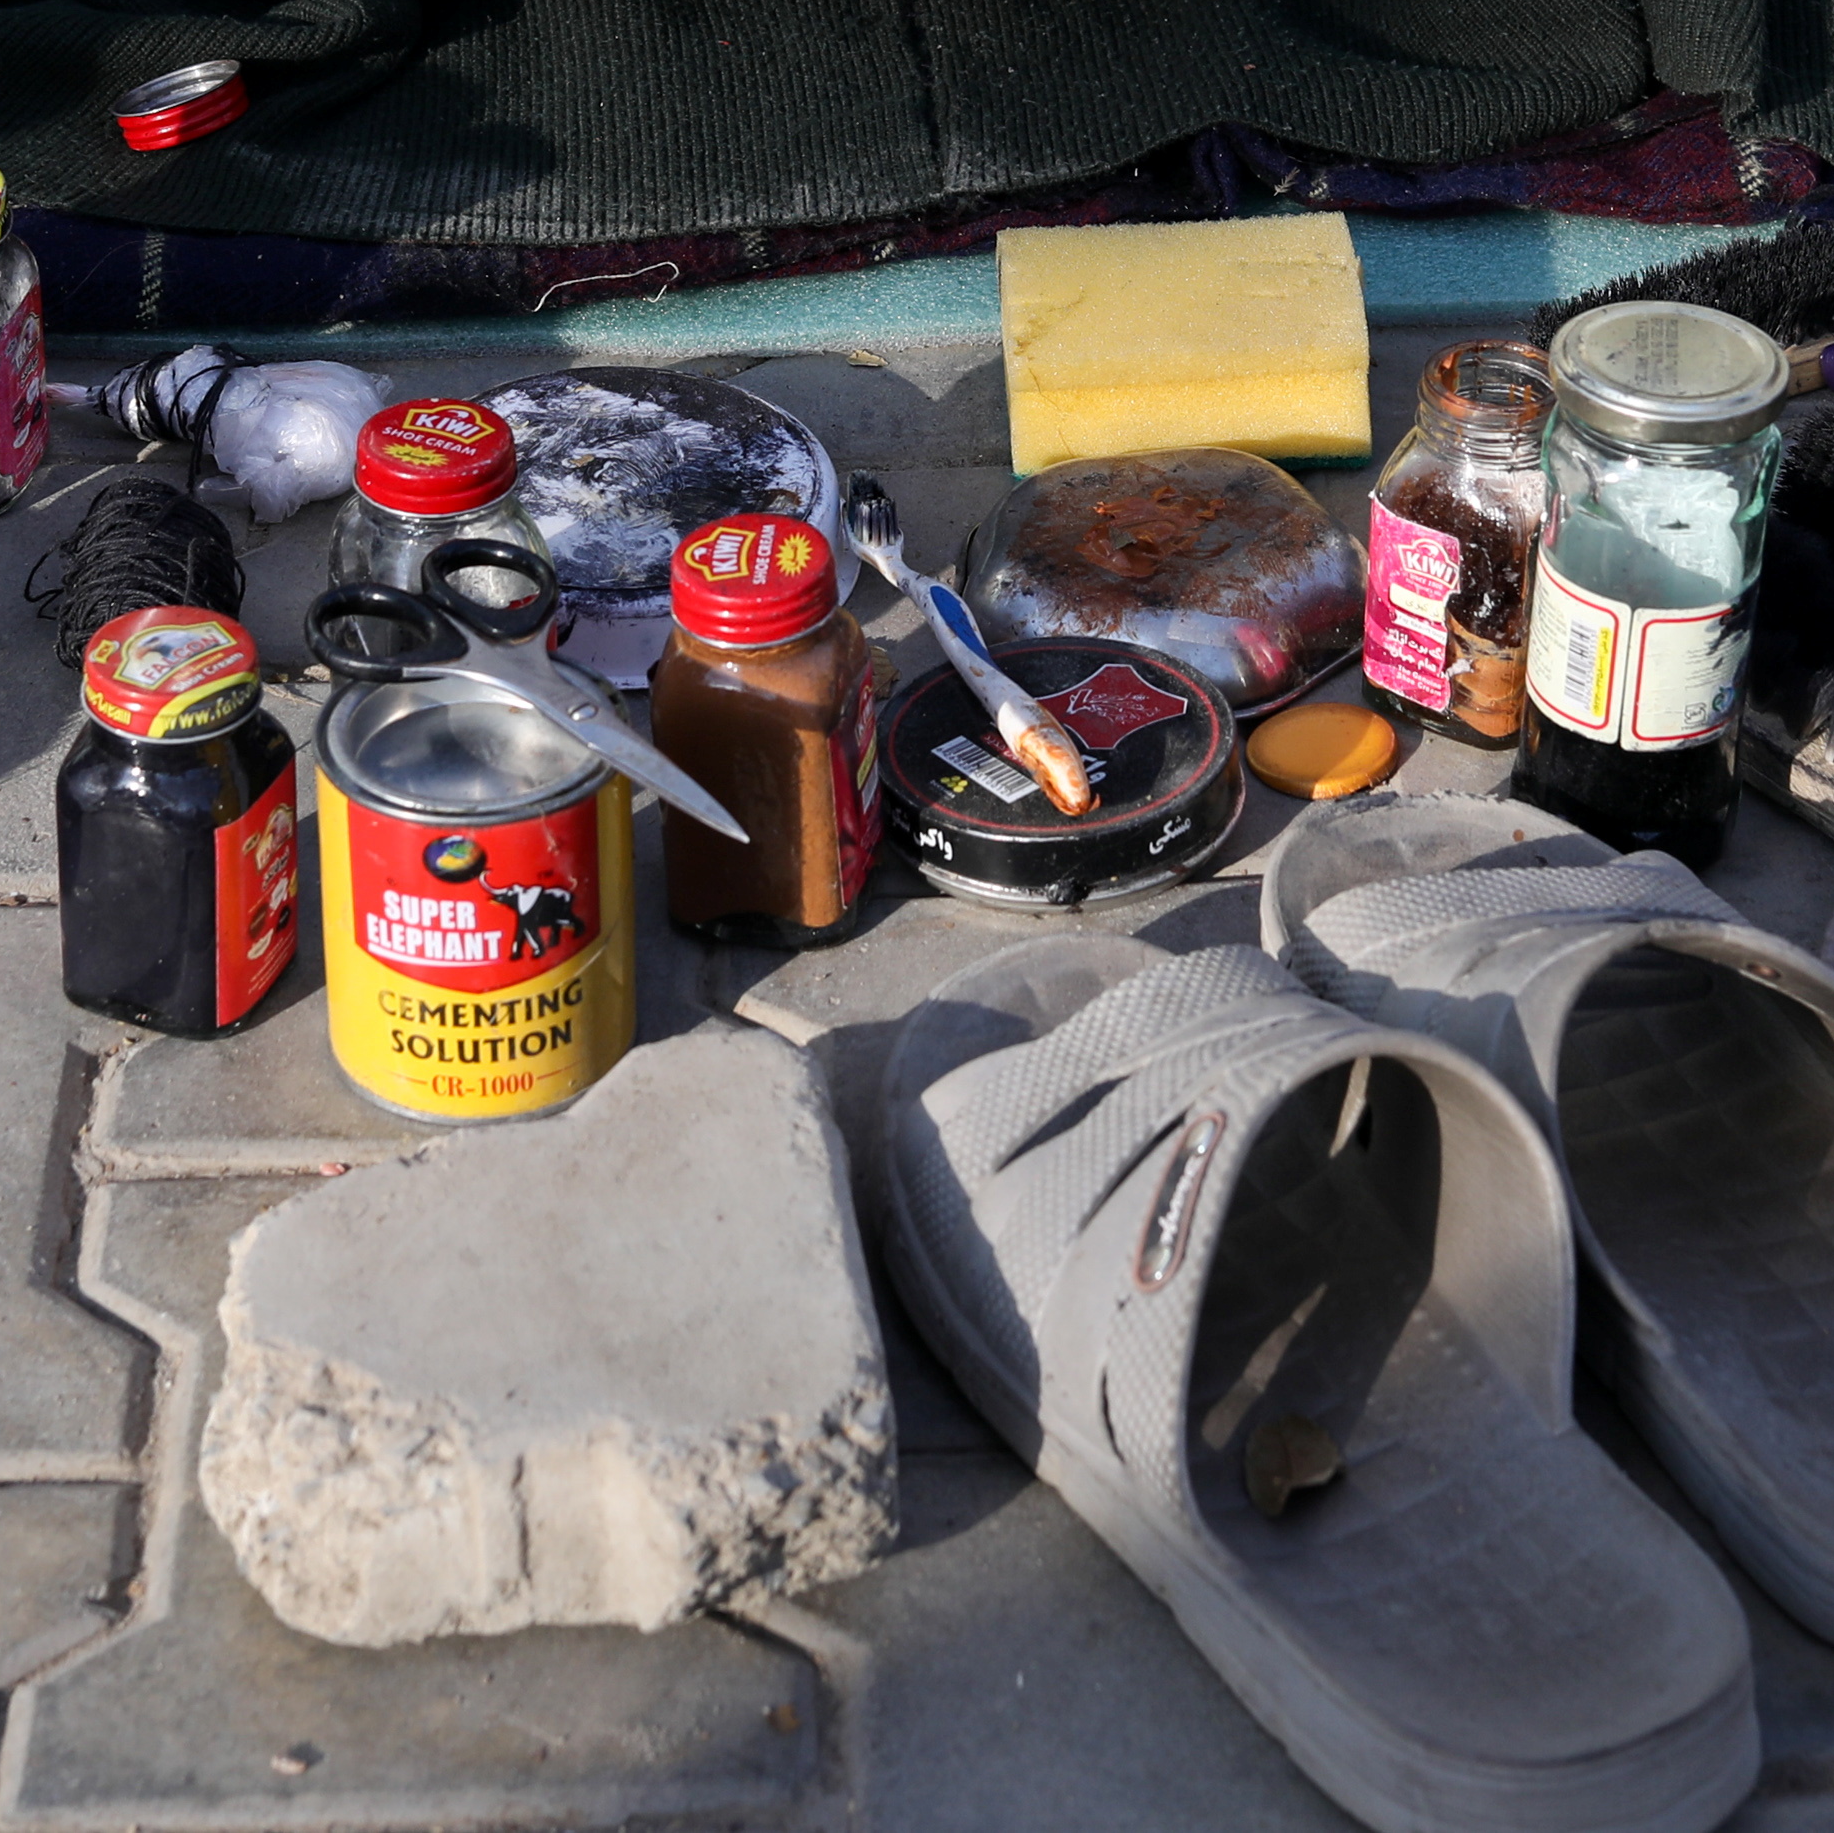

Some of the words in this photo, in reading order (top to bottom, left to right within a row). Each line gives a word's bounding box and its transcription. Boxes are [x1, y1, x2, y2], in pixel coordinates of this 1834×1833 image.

[415, 413, 480, 437] KIWI
[382, 426, 424, 442] SHOE
[425, 437, 477, 457] CREAM
[712, 534, 744, 573] KIWI
[757, 524, 776, 557] CREAM
[752, 557, 770, 585] SHOE
[1405, 550, 1453, 582] KIWI
[141, 634, 221, 680] FALCON
[203, 652, 245, 676] Cream
[1398, 664, 1412, 677] The
[1412, 670, 1442, 690] Genuine
[1417, 680, 1442, 697] Cream
[1149, 814, 1192, 856] مشکی
[383, 889, 476, 930] SUPER
[366, 914, 503, 961] ELEPHANT
[378, 978, 584, 1030] CEMENTING
[391, 1018, 573, 1064] SOLUTION
[431, 1071, 535, 1098] CR-1000
